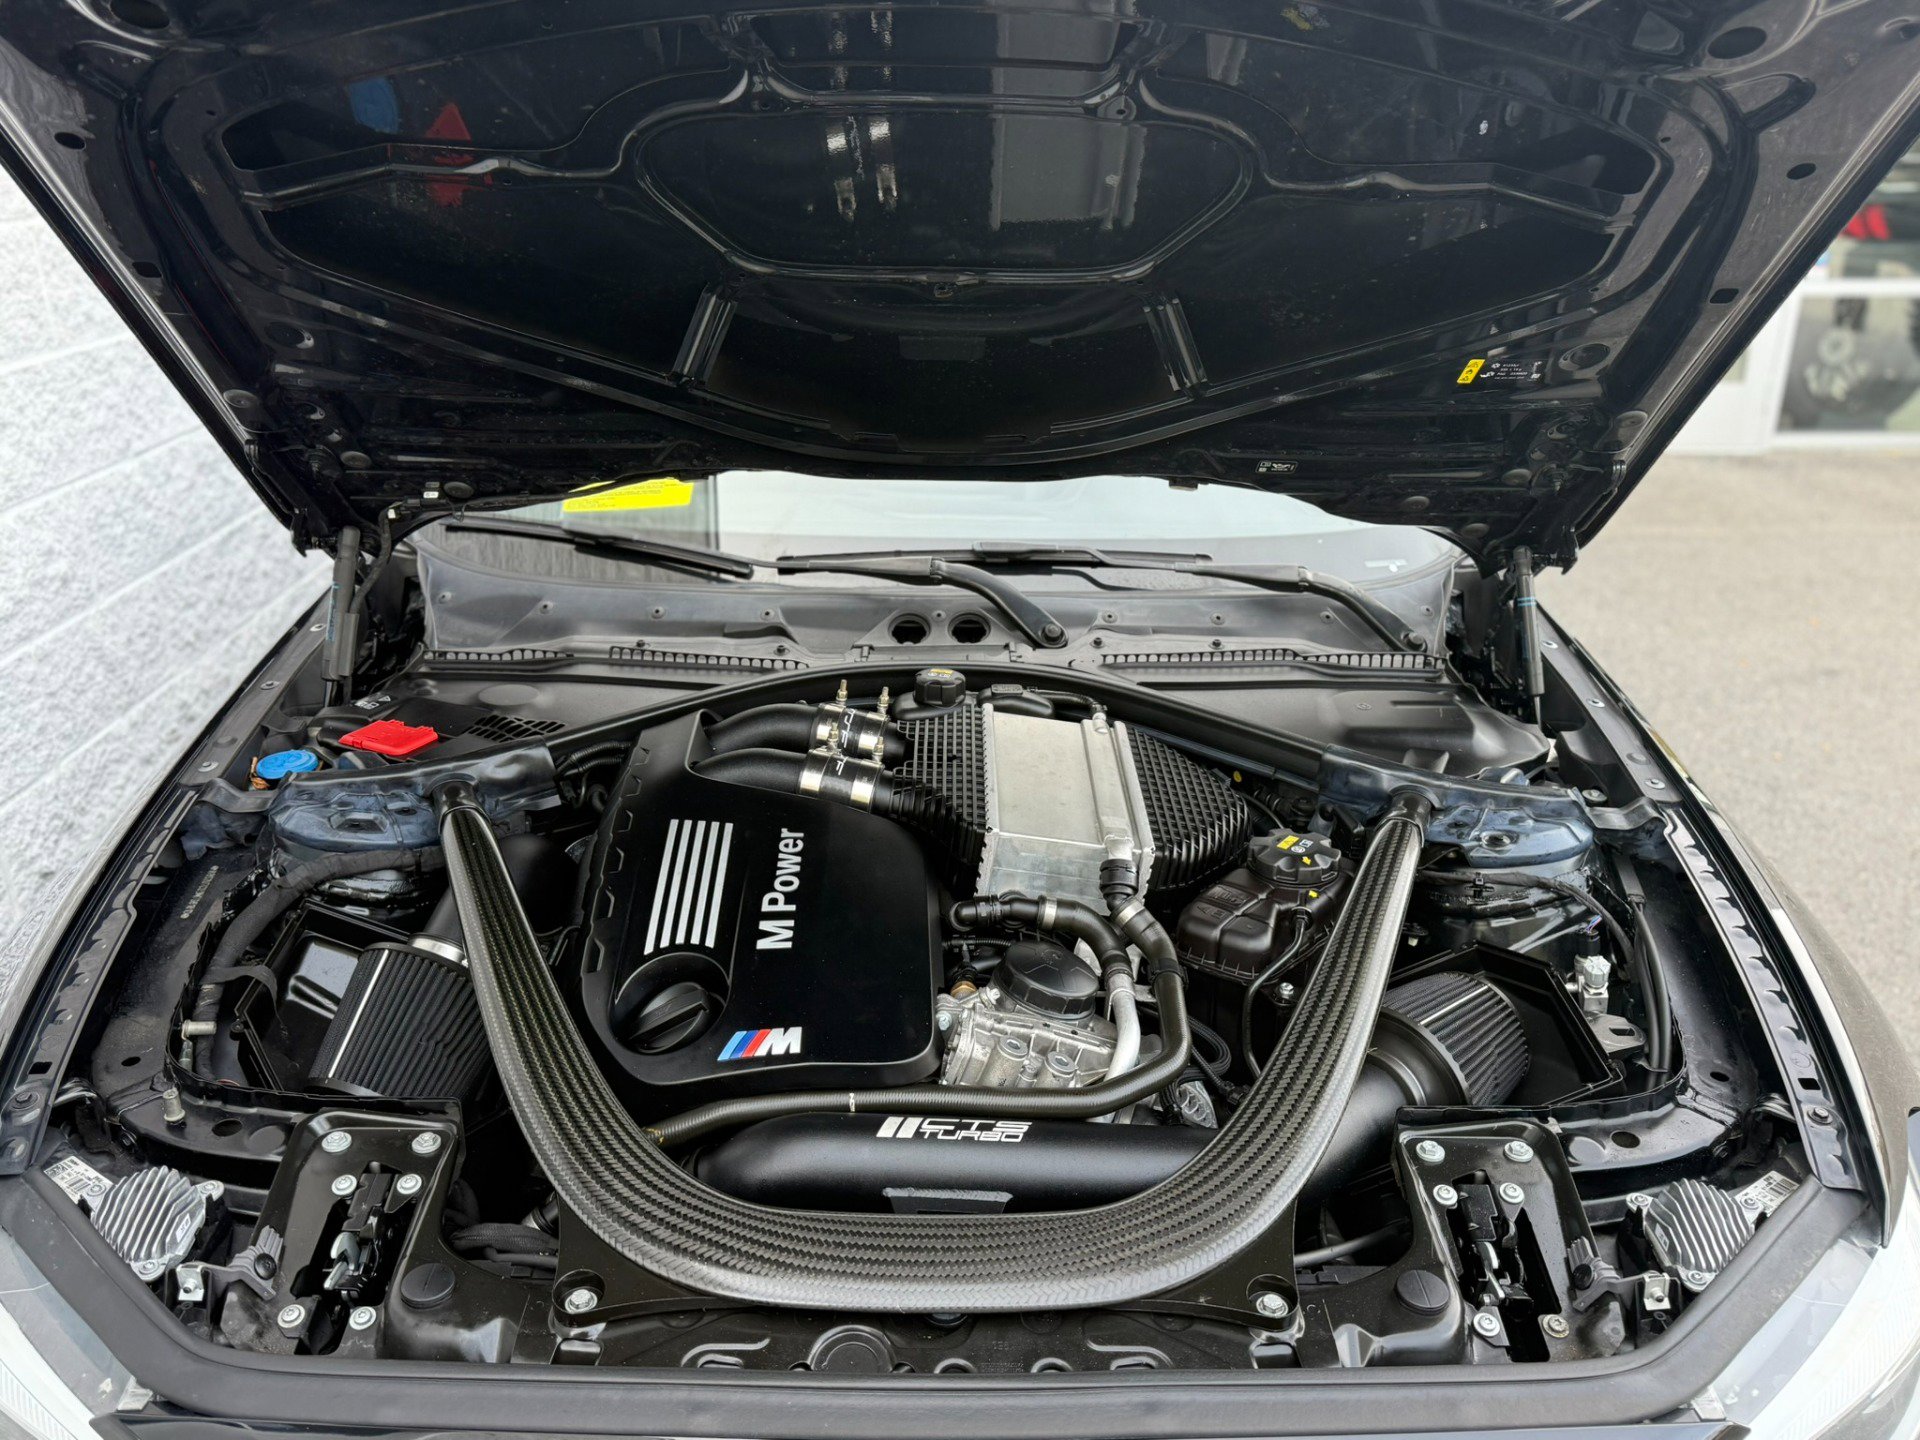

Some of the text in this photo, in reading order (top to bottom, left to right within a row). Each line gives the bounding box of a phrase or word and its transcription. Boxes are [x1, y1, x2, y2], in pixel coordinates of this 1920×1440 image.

[756, 827, 804, 950] M Power
[920, 1118, 1033, 1132] CTS
[919, 1129, 1025, 1143] TURBO
